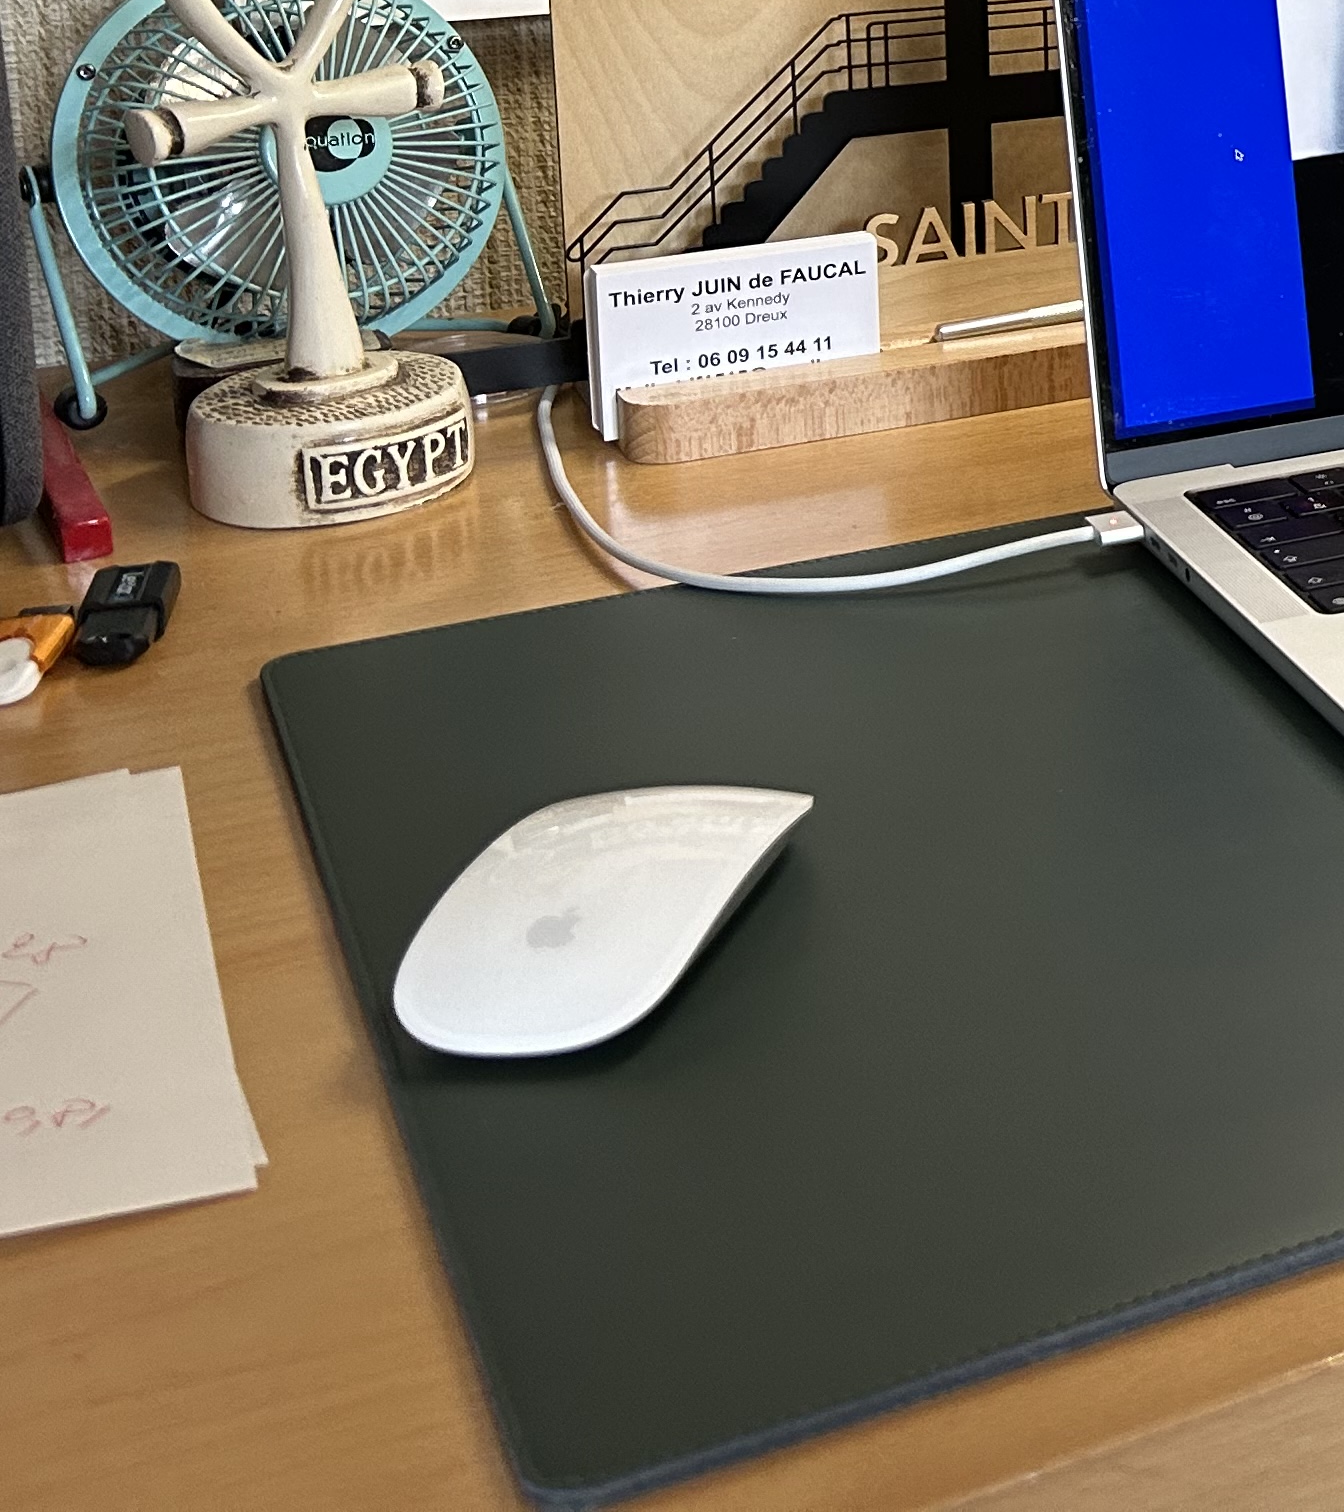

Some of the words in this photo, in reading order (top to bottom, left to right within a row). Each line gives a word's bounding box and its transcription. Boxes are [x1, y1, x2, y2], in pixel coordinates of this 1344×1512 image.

[305, 132, 375, 149] quation
[865, 191, 1073, 266] SAINT
[609, 287, 685, 308] Thierry
[692, 276, 740, 297] JUIN
[749, 273, 773, 288] de
[781, 260, 866, 285] FAUCAL
[691, 303, 700, 315] 2
[705, 302, 722, 314] av
[727, 291, 790, 310] Kennedy
[695, 314, 740, 332] 28100
[746, 310, 788, 325] Dreux
[650, 358, 678, 376] Tel
[698, 353, 721, 368] 06
[727, 348, 749, 364] 09
[757, 344, 778, 360] 15
[784, 339, 807, 355] 44
[813, 336, 832, 351] 11
[319, 421, 466, 503] EGYPT
